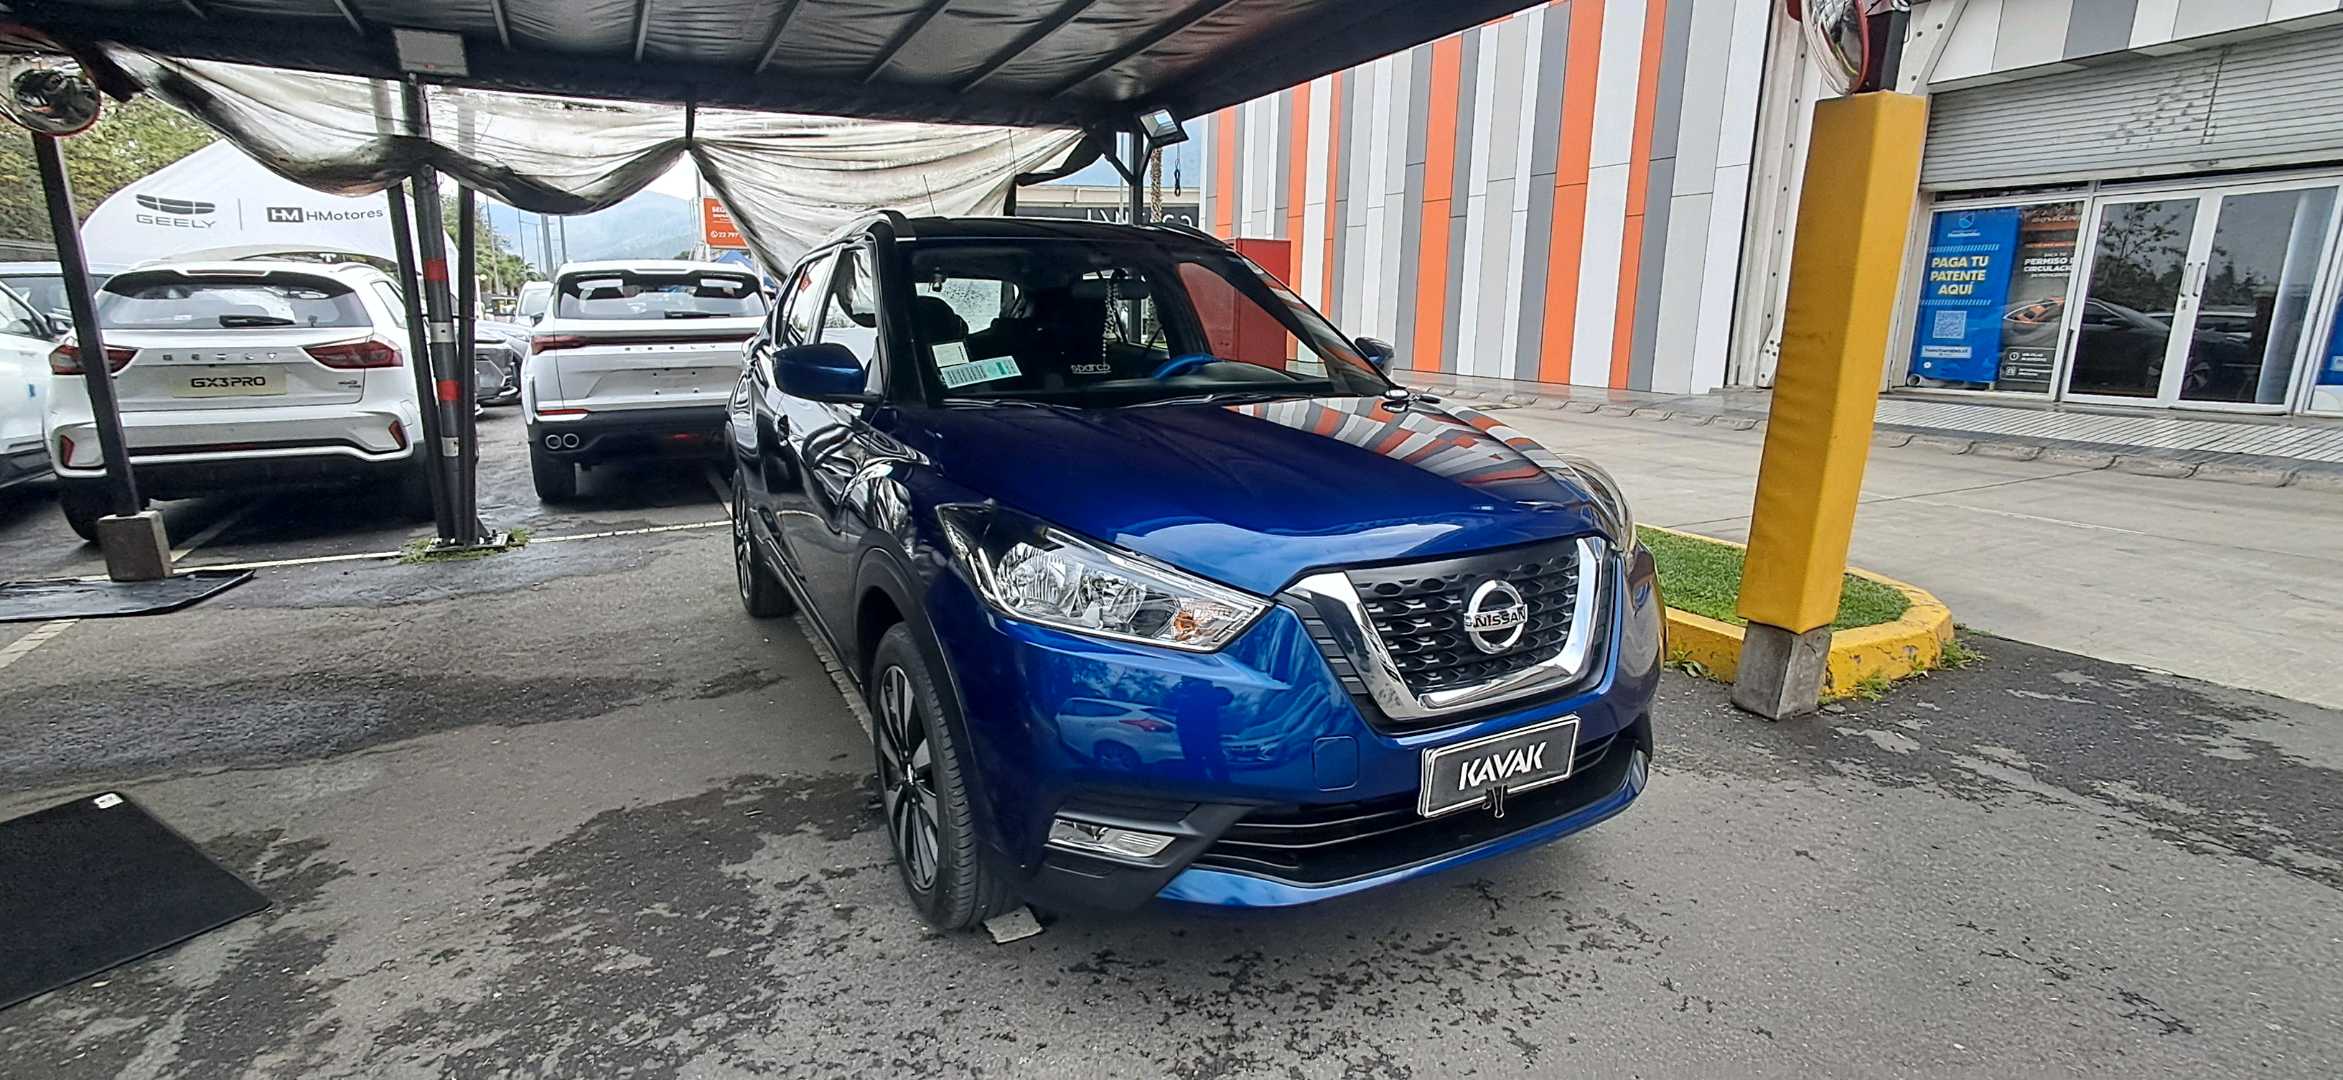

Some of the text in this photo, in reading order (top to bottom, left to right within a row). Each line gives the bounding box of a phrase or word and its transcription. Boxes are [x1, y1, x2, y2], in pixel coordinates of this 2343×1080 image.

[136, 213, 216, 229] GEELY
[270, 208, 384, 222] HM HMotores
[1931, 256, 1990, 268] PAGA TU
[2023, 257, 2068, 266] PERMISO
[1929, 269, 1987, 282] PATENTE
[1937, 281, 1974, 295] AQUÍ
[1474, 606, 1526, 628] NISSAN
[1458, 741, 1548, 791] KAVAK
